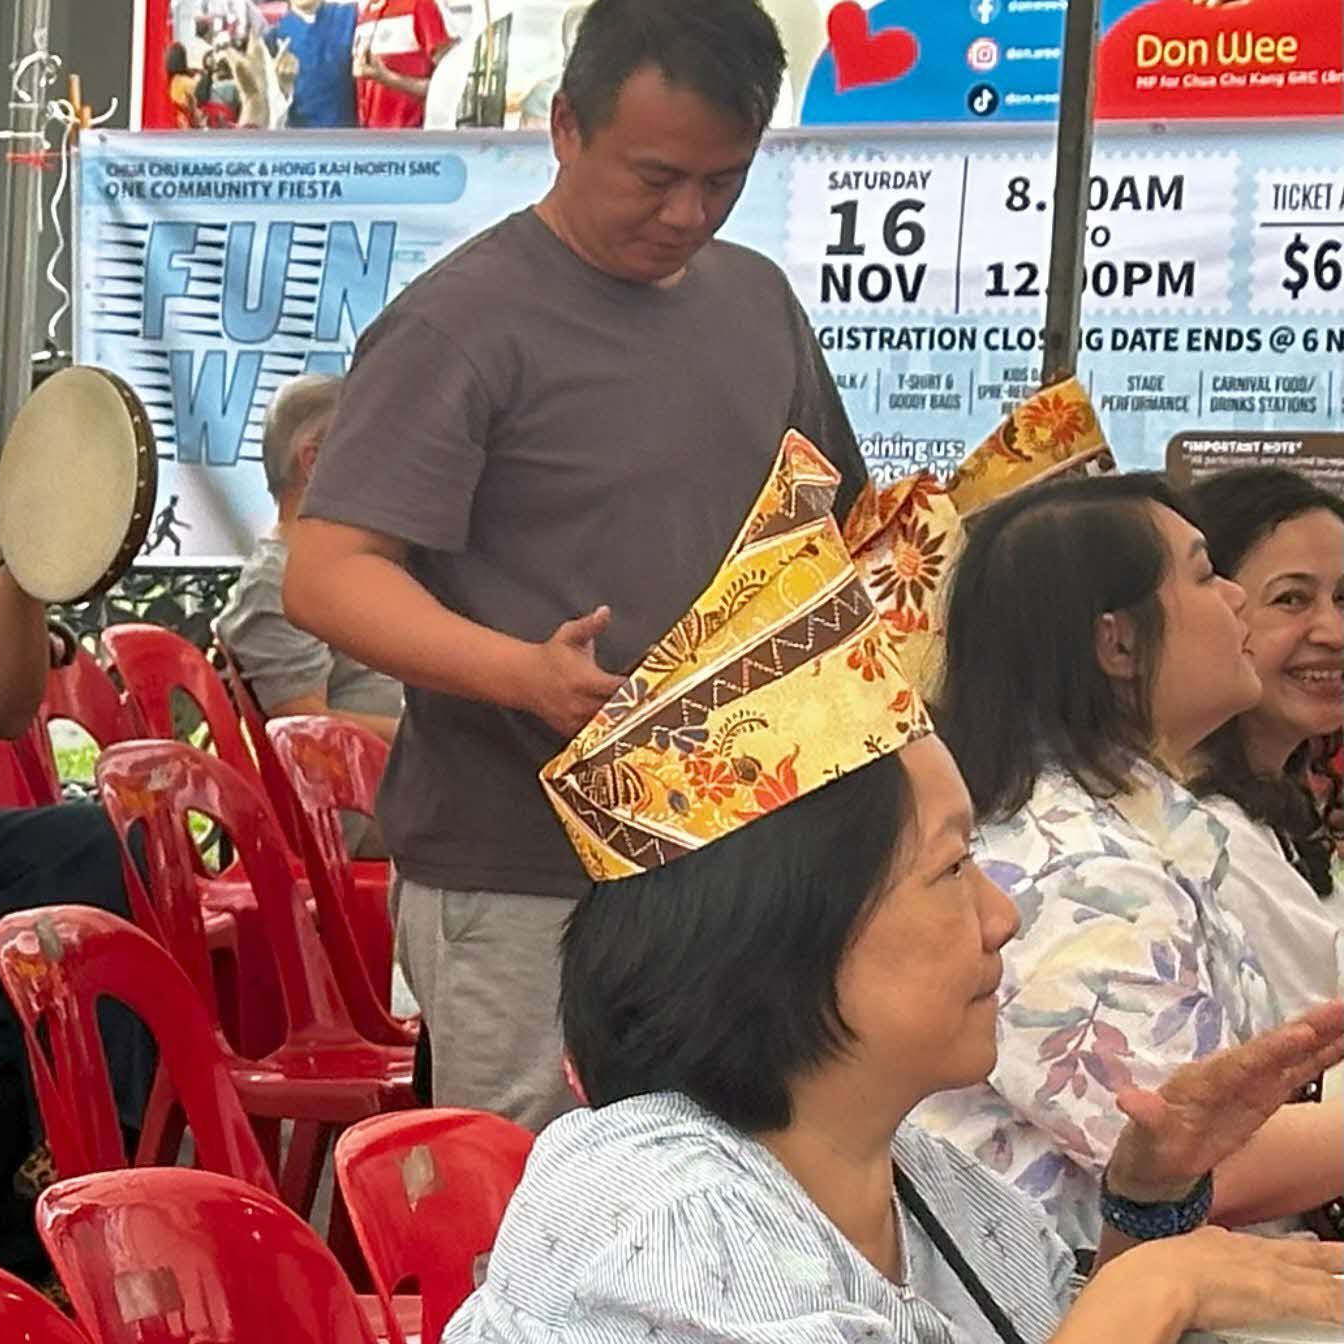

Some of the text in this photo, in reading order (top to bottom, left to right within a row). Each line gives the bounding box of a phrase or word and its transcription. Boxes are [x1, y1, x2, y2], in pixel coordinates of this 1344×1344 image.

[1137, 31, 1298, 67] Don Wee
[1160, 75, 1180, 88] for
[1182, 73, 1217, 88] Chua
[1219, 72, 1246, 87] Chu
[1249, 72, 1285, 88] Kang
[1287, 71, 1319, 85] GRC
[105, 160, 441, 177] CHUA CHU KANG GRC & HONG KAH NORTH SMC
[105, 179, 343, 199] ONE COMMUNITY FIESTA
[827, 169, 932, 191] SATURDAY
[1005, 173, 1185, 213] 8.0AM
[1272, 182, 1333, 211] TICKET
[825, 197, 926, 257] 16
[143, 220, 397, 345] FUN
[819, 262, 928, 304] NOV
[817, 325, 977, 351] GISTRATION
[1111, 327, 1180, 352] DATE
[1186, 327, 1262, 352] ENDS
[1268, 325, 1296, 354] @
[1302, 327, 1319, 352] 6
[897, 373, 942, 390] T-SHIRT
[1127, 374, 1165, 392] STAGE
[1212, 375, 1271, 392] CARNIVAL
[889, 393, 962, 410] GOODY BAGS
[1100, 394, 1190, 413] PERFORMANCE
[1210, 395, 1255, 413] DRINKS
[1258, 395, 1317, 414] STATIONS
[858, 432, 928, 462] oining
